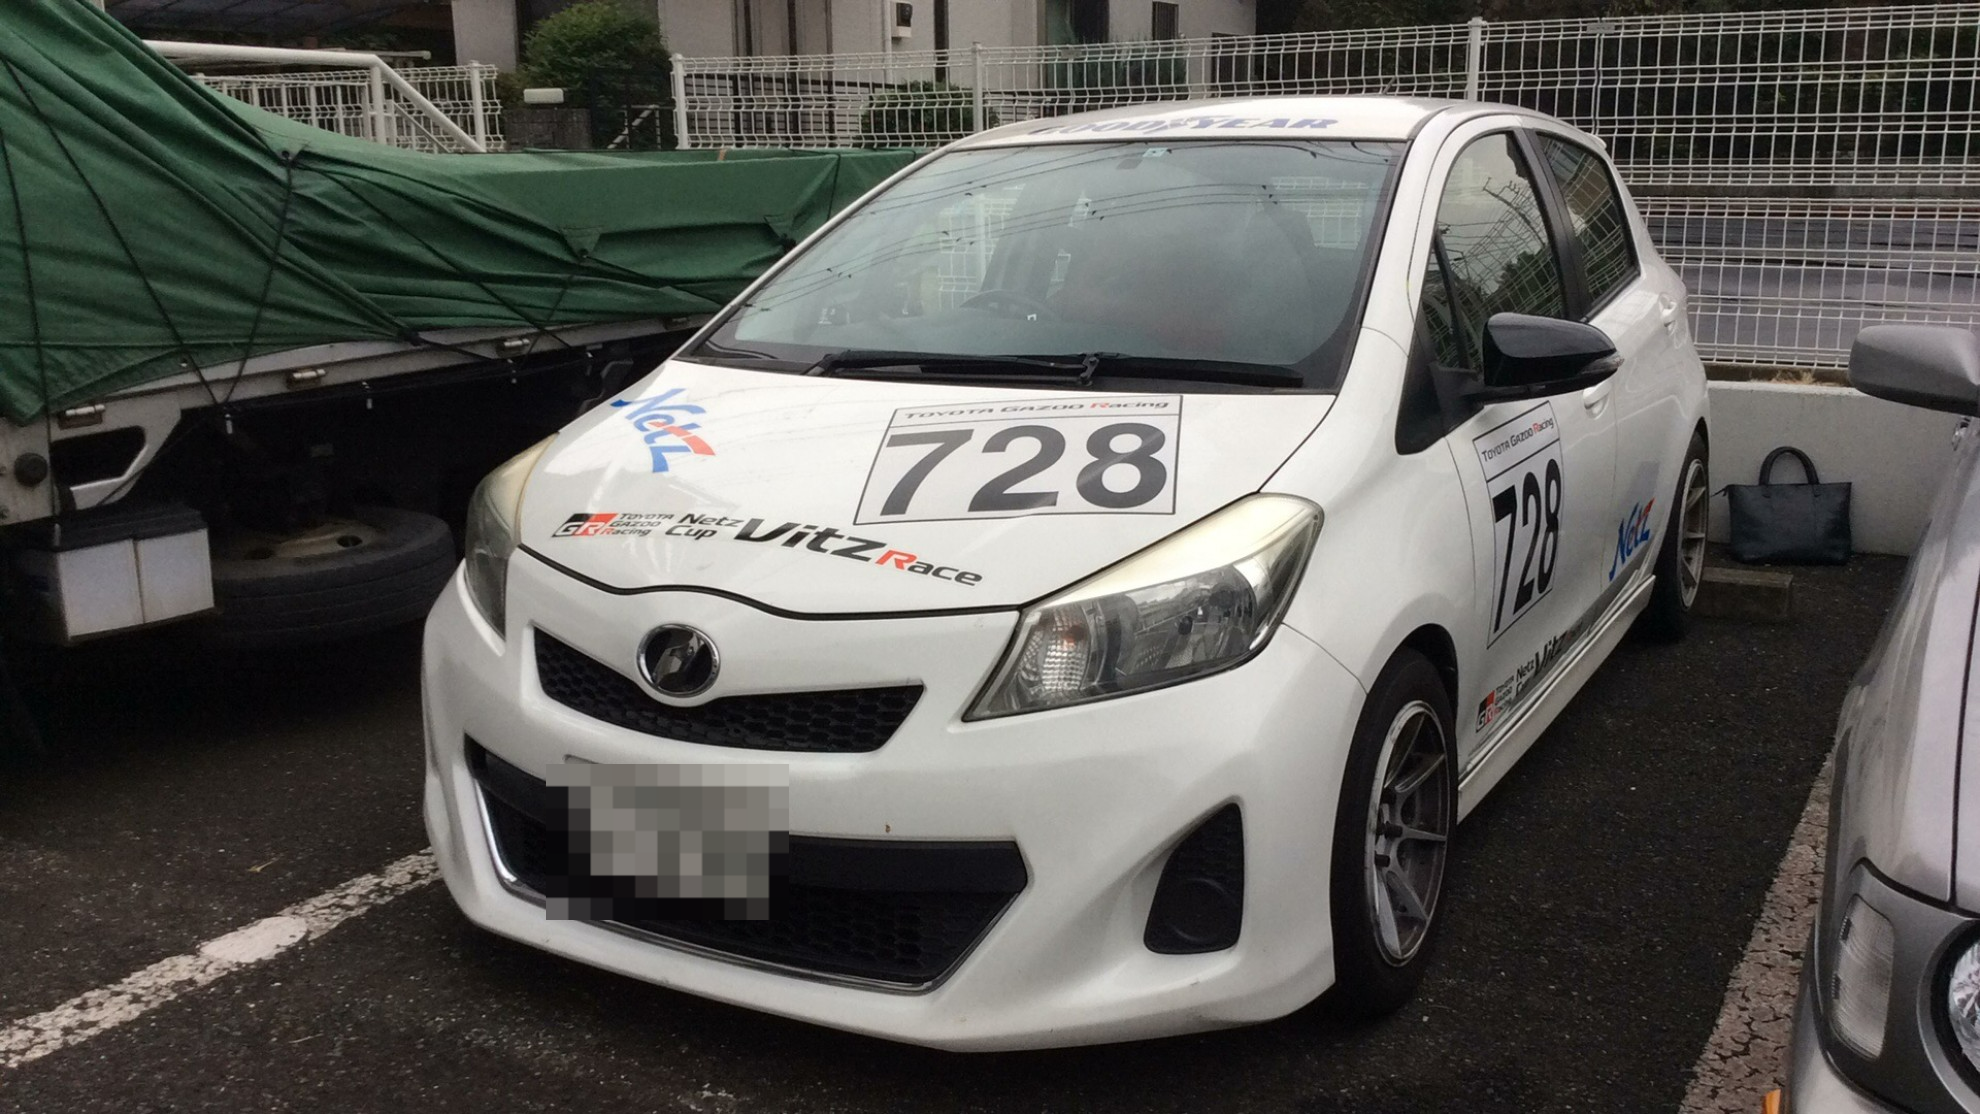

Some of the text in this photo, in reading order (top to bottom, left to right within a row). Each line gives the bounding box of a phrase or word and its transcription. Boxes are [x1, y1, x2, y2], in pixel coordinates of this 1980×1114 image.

[905, 401, 1169, 420] TOYOTA GAZOO Racing
[1482, 417, 1554, 462] TOYOTA GAZOO Racing
[880, 422, 1167, 516] 728
[677, 513, 745, 528] Netz
[601, 527, 652, 537] Racing
[665, 525, 718, 540] Cup
[1492, 458, 1562, 634] 728
